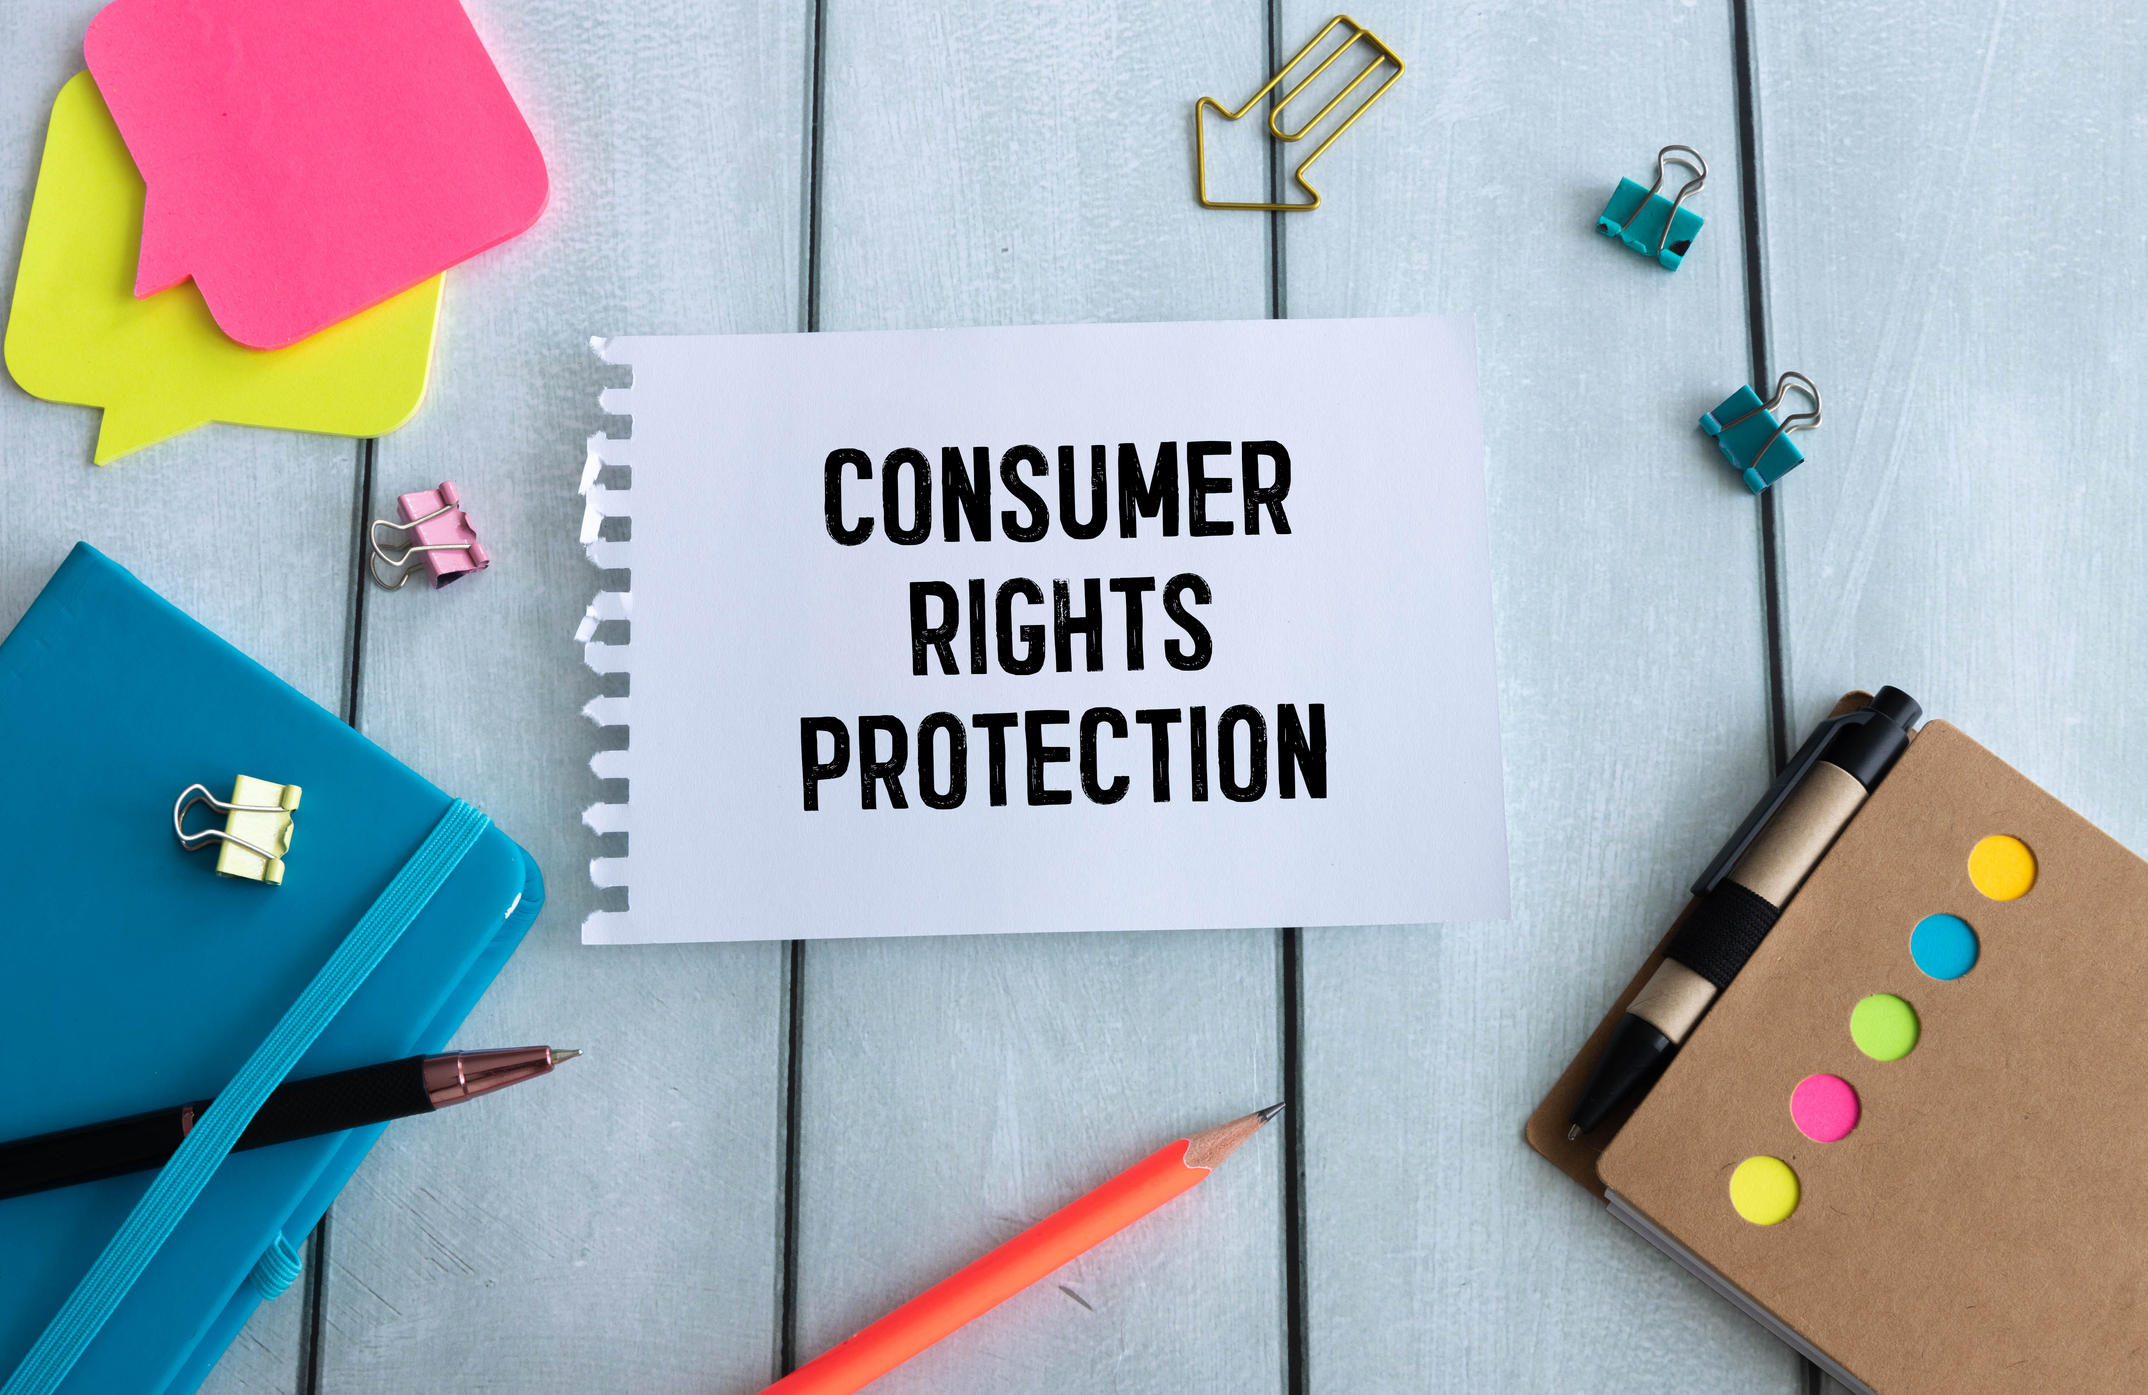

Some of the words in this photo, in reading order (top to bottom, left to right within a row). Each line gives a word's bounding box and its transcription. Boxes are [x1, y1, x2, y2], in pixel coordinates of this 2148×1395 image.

[824, 440, 1292, 547] CONSUMER
[909, 572, 1213, 677] RIGHTS
[800, 703, 1328, 812] PROTECTION
